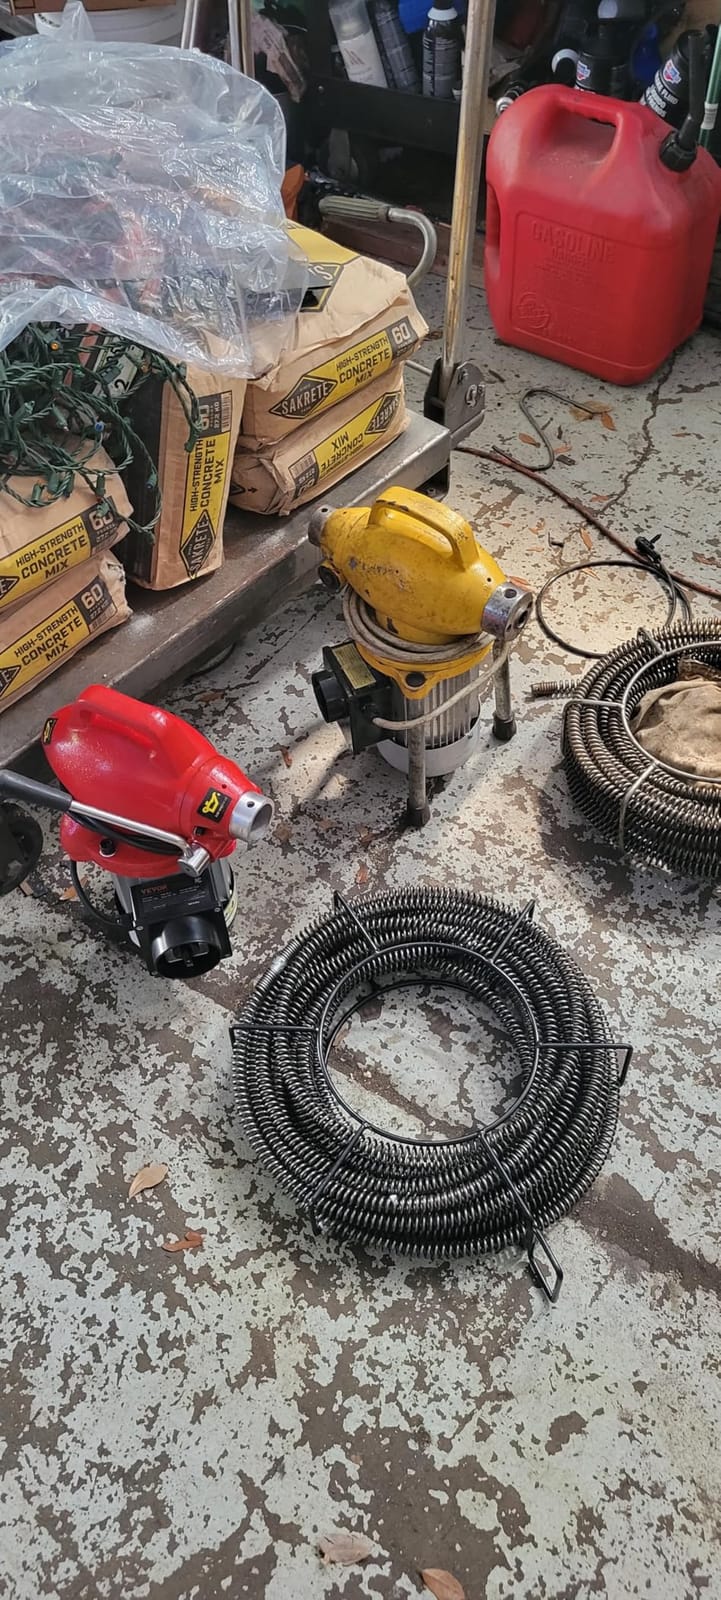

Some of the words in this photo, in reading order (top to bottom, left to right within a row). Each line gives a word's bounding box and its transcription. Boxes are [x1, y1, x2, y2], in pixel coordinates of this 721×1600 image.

[531, 220, 616, 264] GASOLINE
[391, 322, 411, 345] 60
[335, 336, 389, 372] HIGH-STRENGTH
[338, 348, 391, 384] CONCRETE
[353, 369, 375, 387] MIX
[280, 381, 330, 416] SAKRETE
[320, 433, 364, 471] CONCRETE
[331, 431, 350, 452] MIX
[190, 439, 204, 512] HIGH-STRENGTH
[200, 439, 216, 508] CONCRETE
[214, 458, 225, 484] MIX
[16, 522, 85, 568] HIGH-STRENGTH
[21, 534, 88, 580] CONCRETE
[190, 519, 209, 572] SAKRETE
[44, 559, 70, 579] MIX
[81, 583, 104, 609] 60
[14, 605, 79, 658] HIGH-STRENGTH
[22, 616, 83, 666] CONCRETE
[45, 640, 69, 662] MIX
